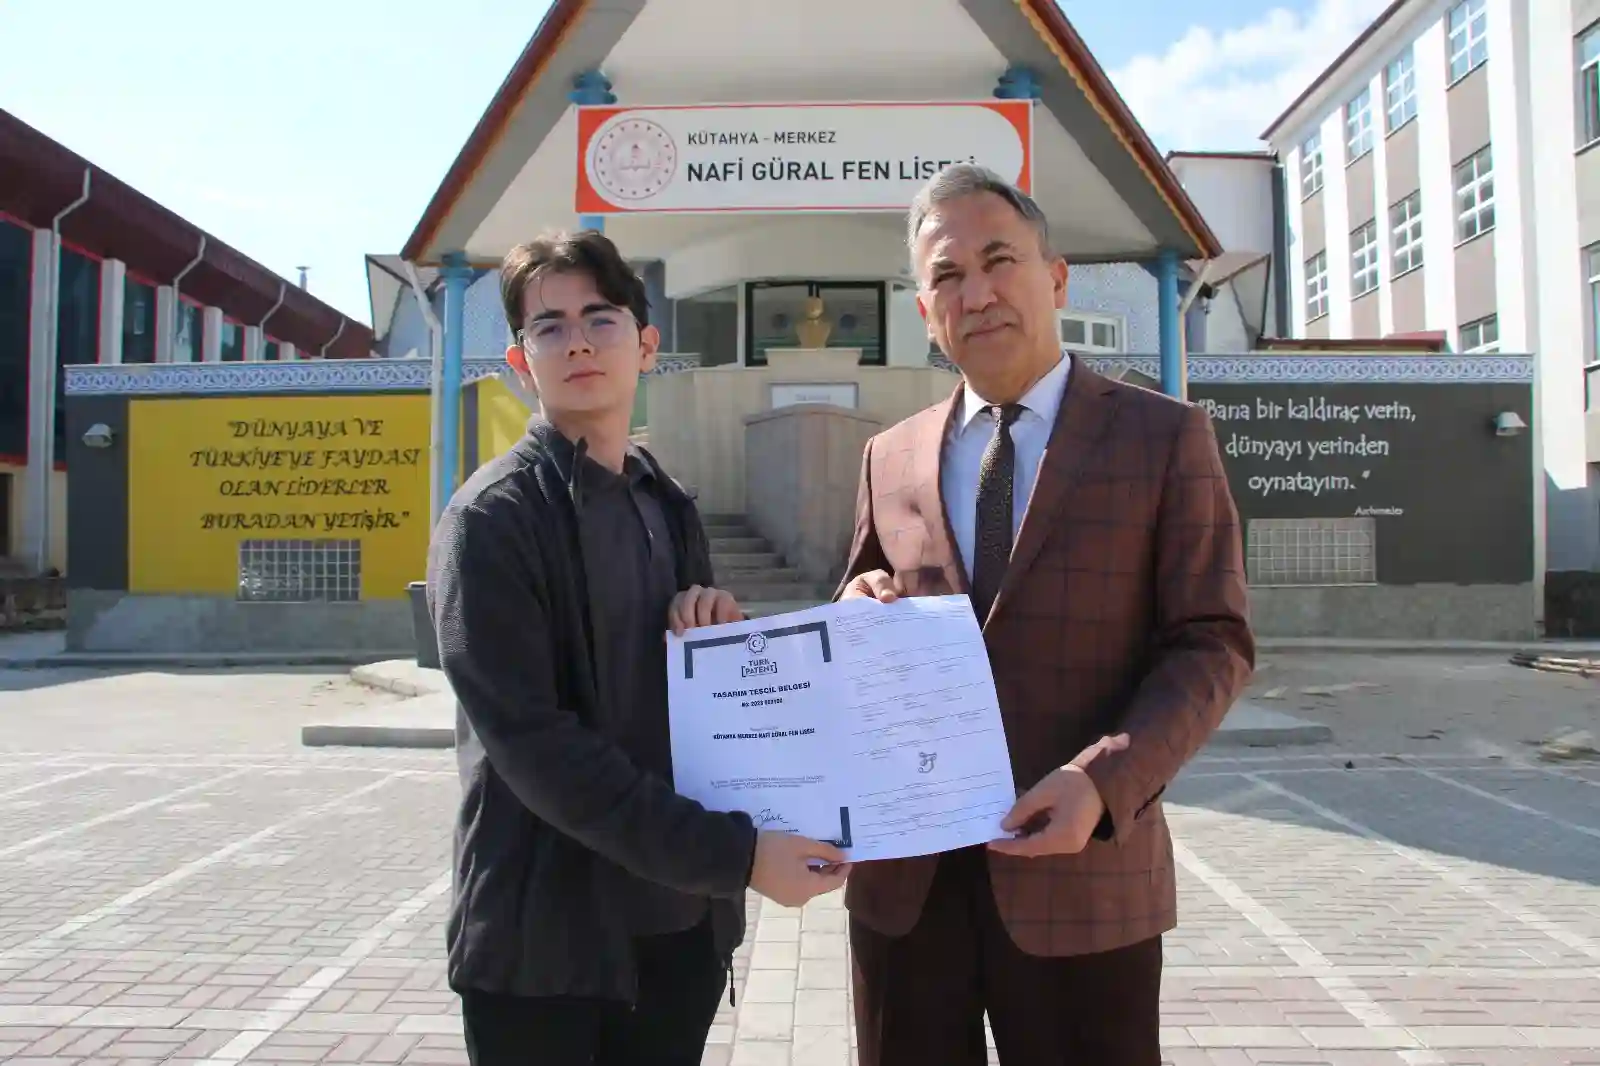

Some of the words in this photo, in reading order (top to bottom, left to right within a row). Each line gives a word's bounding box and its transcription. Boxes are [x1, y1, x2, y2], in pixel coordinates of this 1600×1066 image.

[687, 129, 759, 145] KÜTAHYA
[773, 129, 837, 144] MERKEZ
[687, 156, 744, 182] NAFİ
[751, 156, 834, 182] GÜRAL
[842, 160, 892, 182] FEN
[899, 155, 976, 181] LİS
[1256, 397, 1284, 419] bir
[1288, 397, 1361, 423] kaldıraç
[1364, 400, 1417, 422] verin,
[351, 416, 384, 437] VE
[1225, 432, 1303, 461] dünyayı
[1307, 433, 1390, 461] yerinden
[318, 447, 421, 470] FAYDASI
[219, 479, 284, 497] OLAN
[284, 475, 392, 497] LİDERLER
[200, 512, 318, 531] BURADAN
